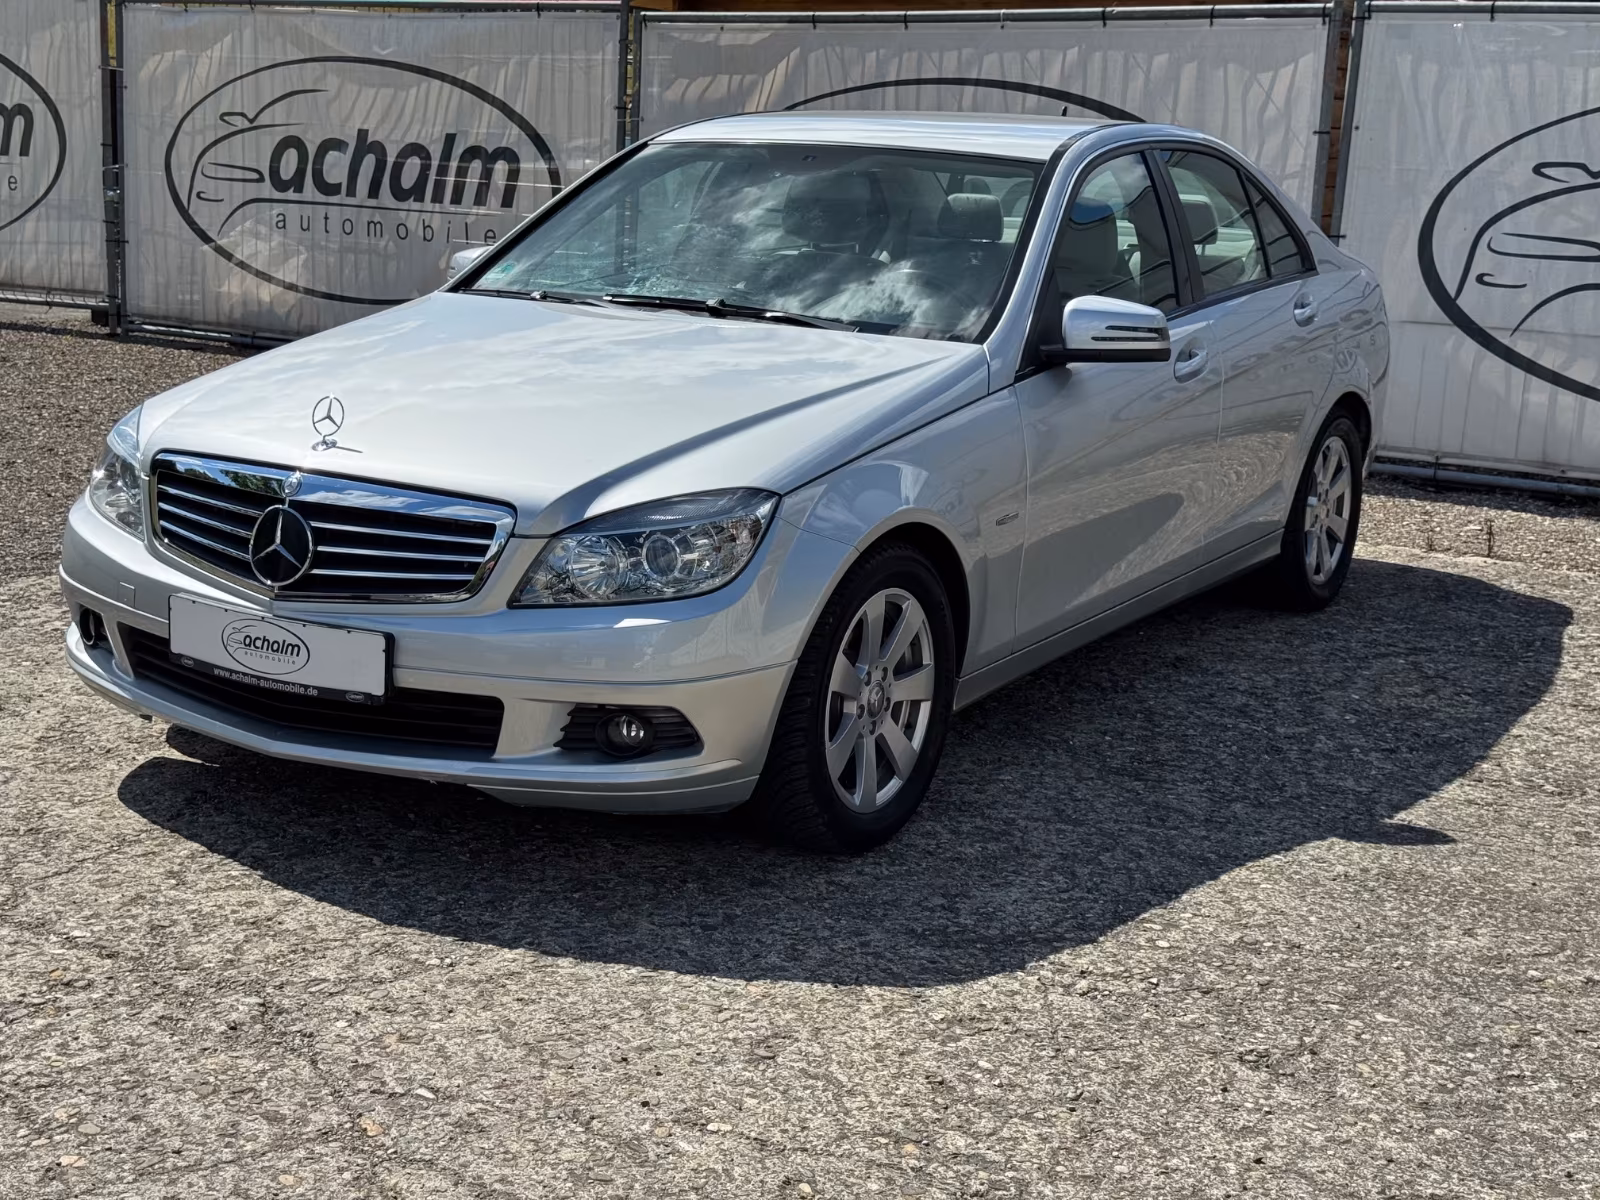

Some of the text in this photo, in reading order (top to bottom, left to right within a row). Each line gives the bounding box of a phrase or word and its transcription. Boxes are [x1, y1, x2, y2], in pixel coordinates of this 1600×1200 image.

[269, 128, 521, 208] achalm
[275, 211, 498, 246] automobile
[243, 634, 301, 657] achalm
[244, 650, 296, 665] automobile
[213, 667, 318, 697] www.achalm-automobile.de
